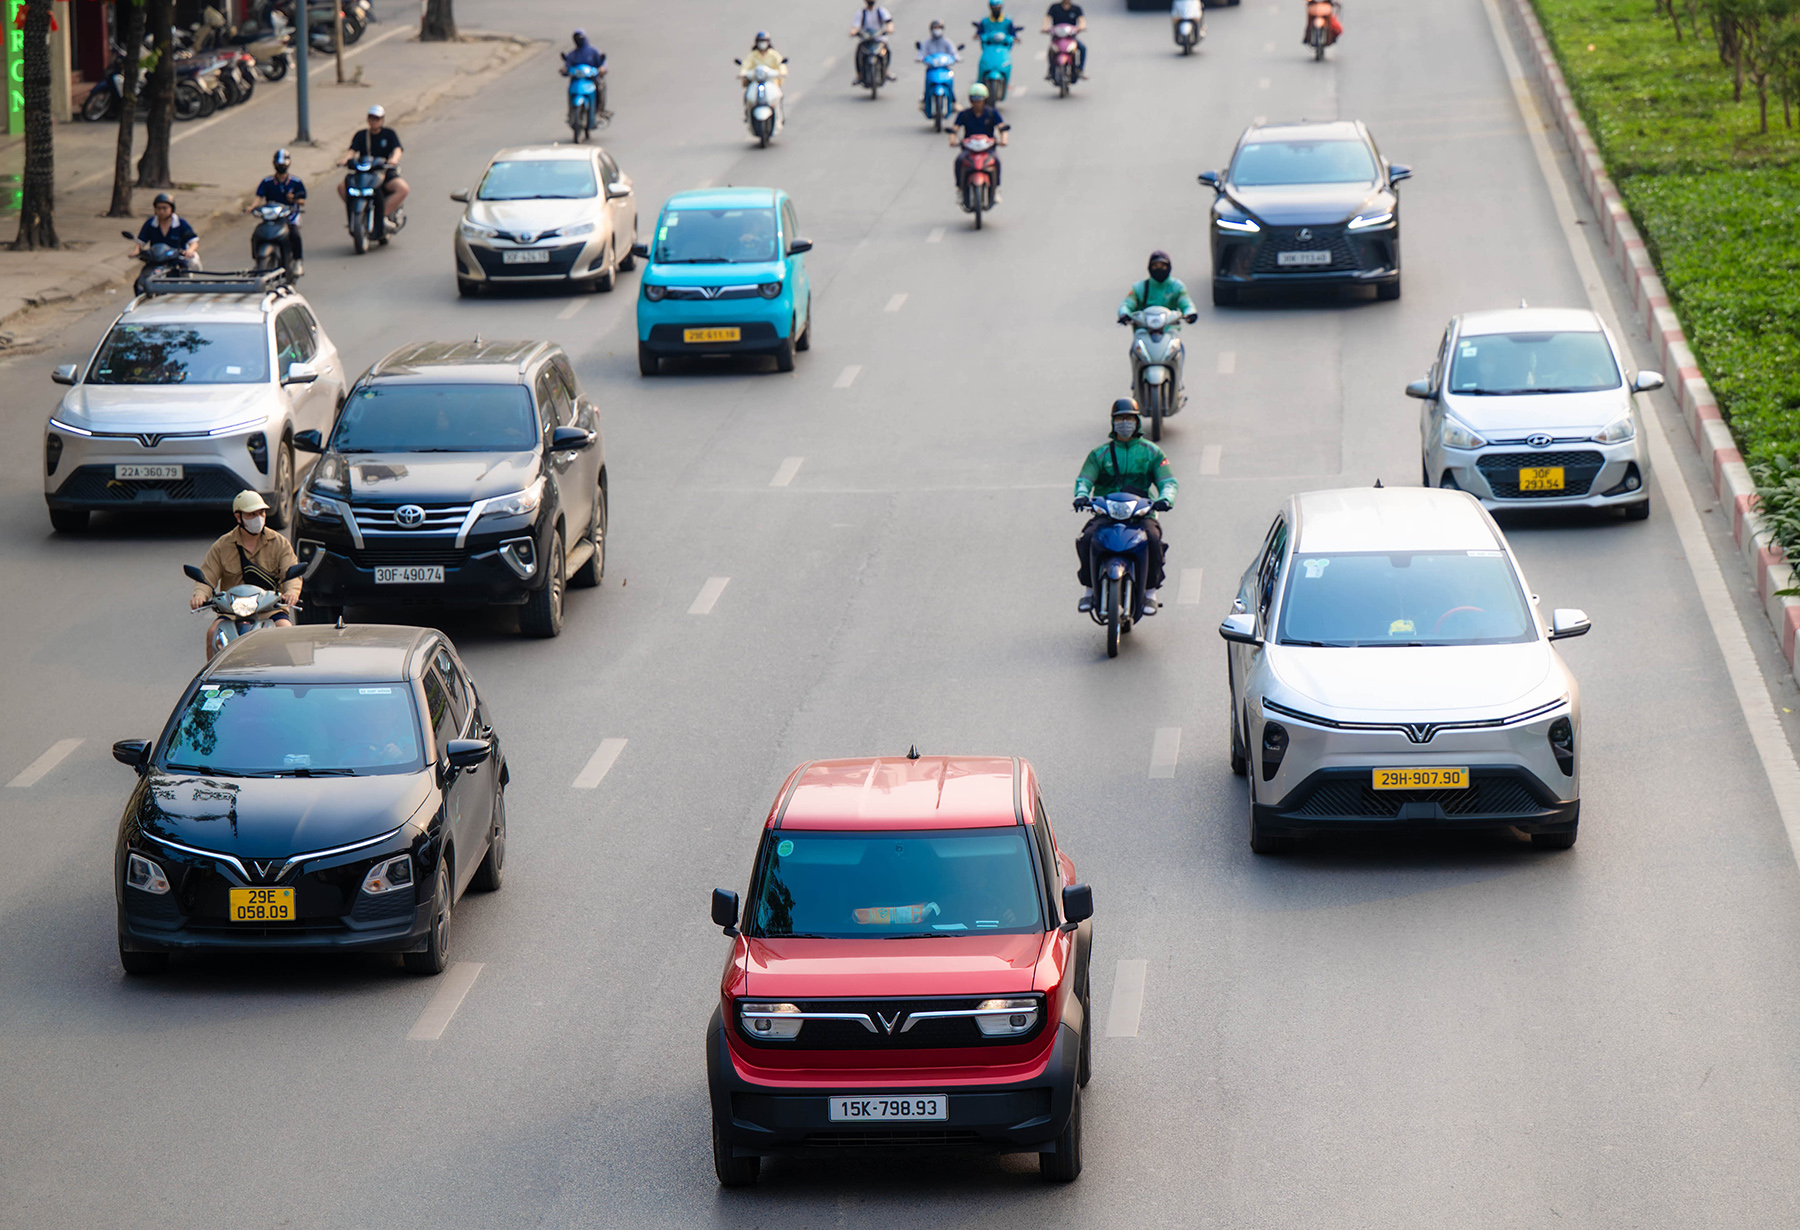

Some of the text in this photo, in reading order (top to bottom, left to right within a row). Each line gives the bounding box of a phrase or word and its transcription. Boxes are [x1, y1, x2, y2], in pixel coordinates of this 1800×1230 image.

[121, 467, 178, 477] 22A-360.79
[377, 568, 442, 581] 30F-490.74
[1381, 771, 1460, 785] 29H-907.90
[248, 890, 276, 904] 29E
[237, 905, 288, 919] 058.09
[841, 1100, 937, 1117] 15K-798.93
